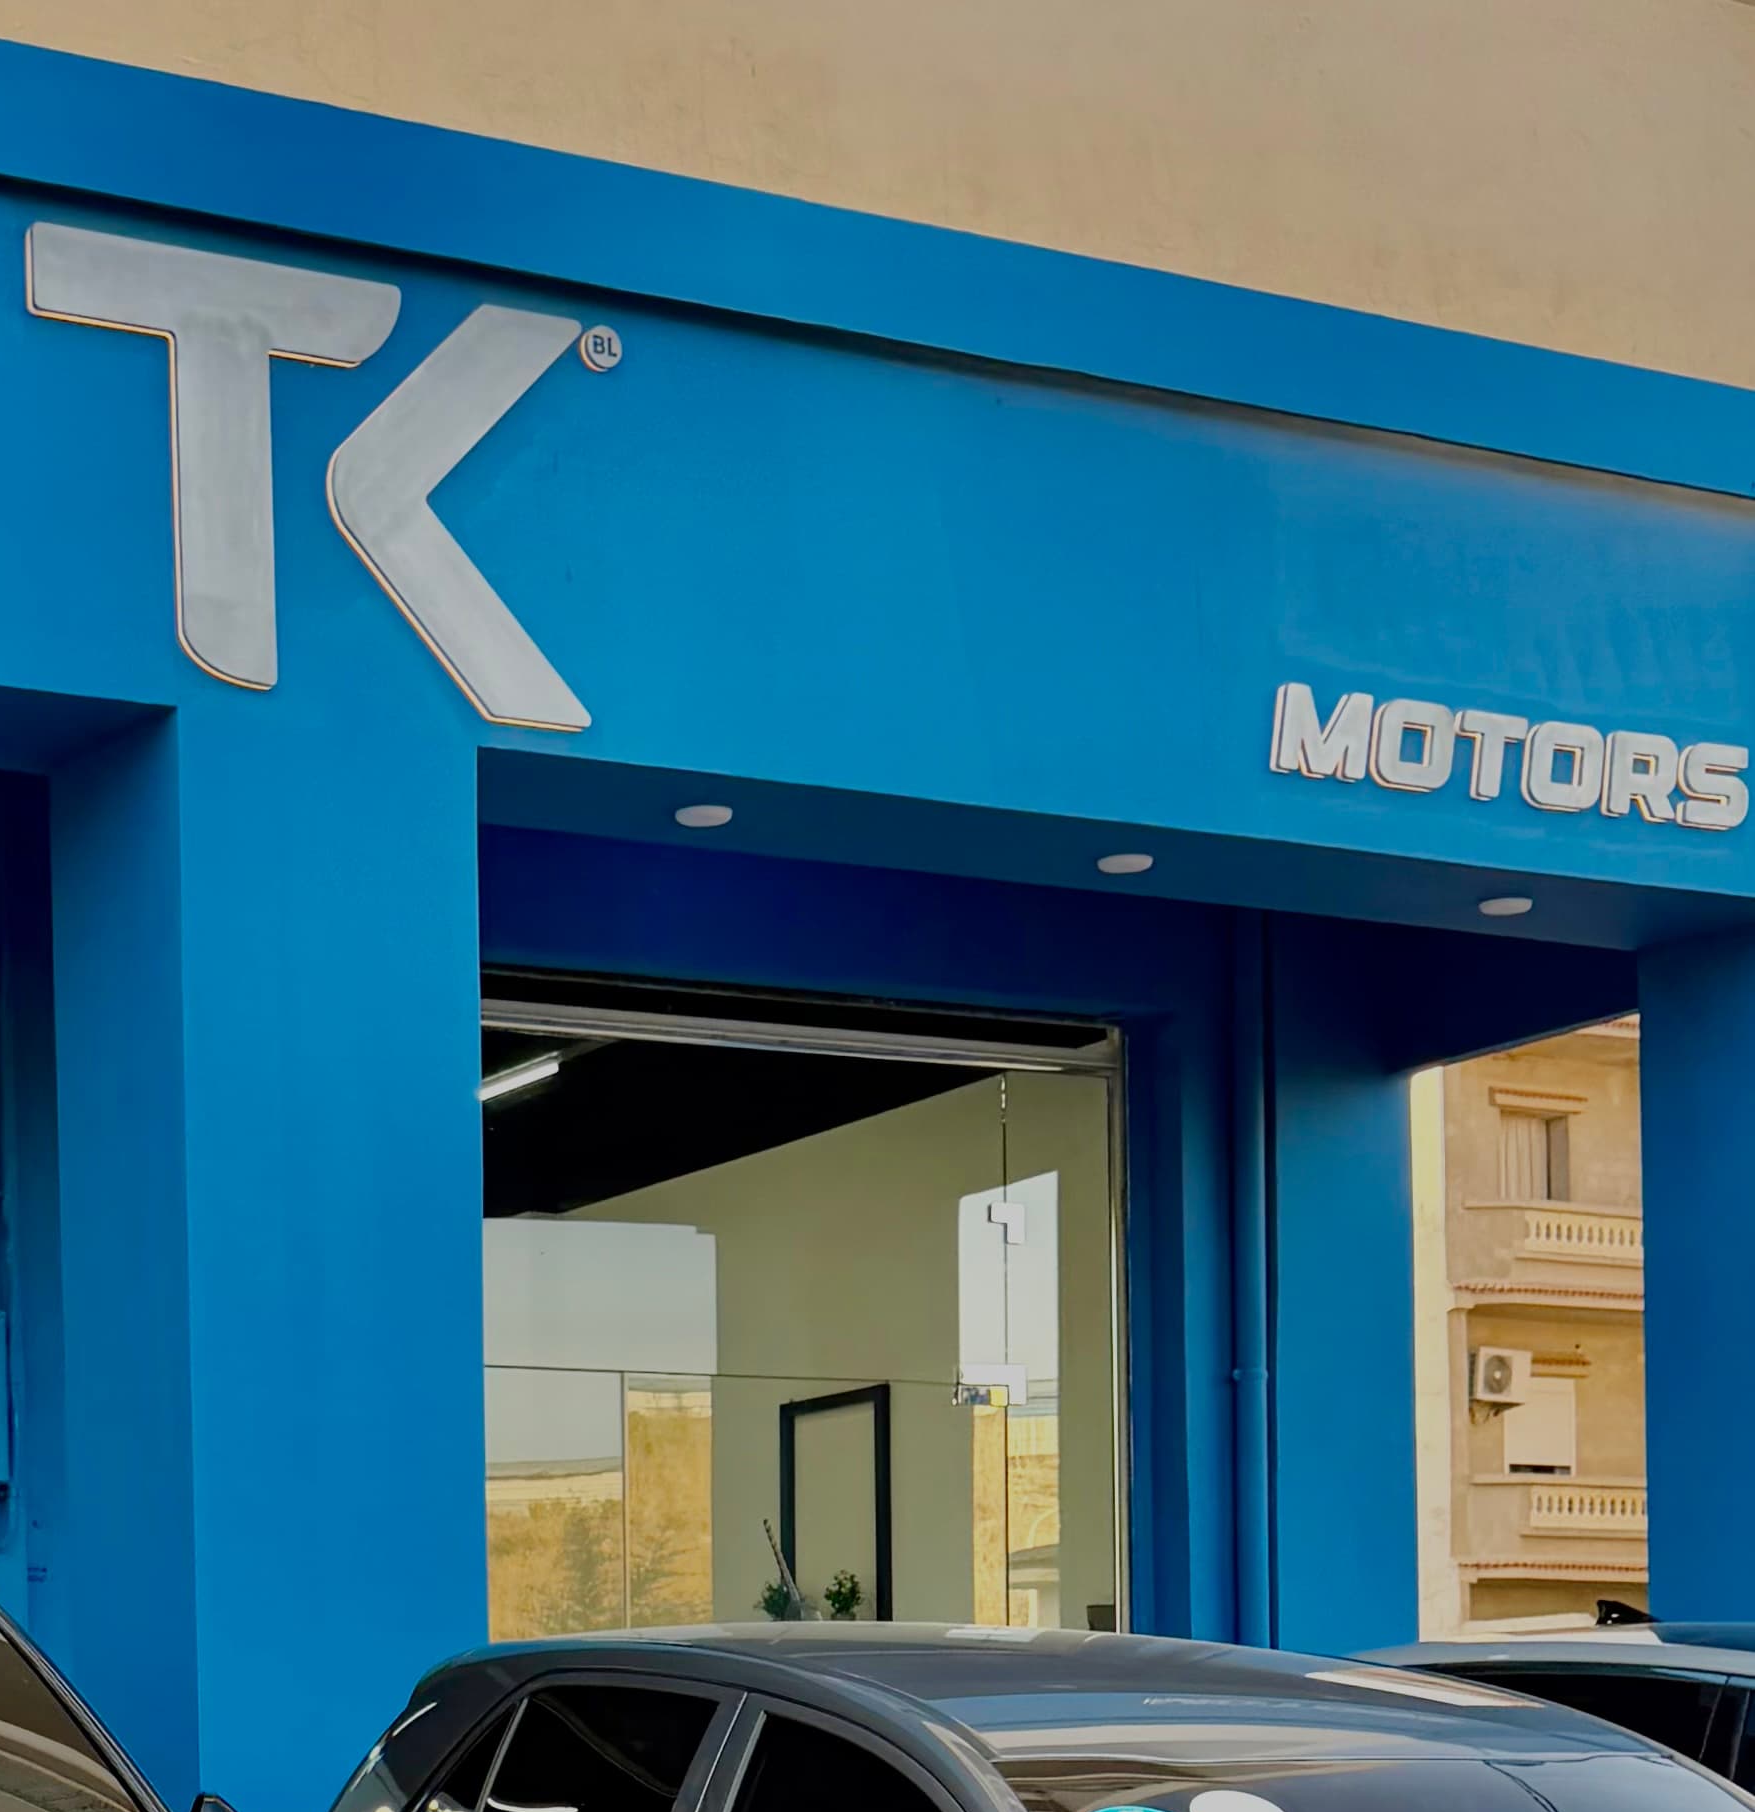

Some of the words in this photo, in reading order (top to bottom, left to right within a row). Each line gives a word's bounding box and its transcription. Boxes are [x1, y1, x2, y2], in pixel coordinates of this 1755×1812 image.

[592, 333, 619, 358] BL
[24, 221, 593, 733] TK
[1269, 682, 1750, 831] MOTORS
